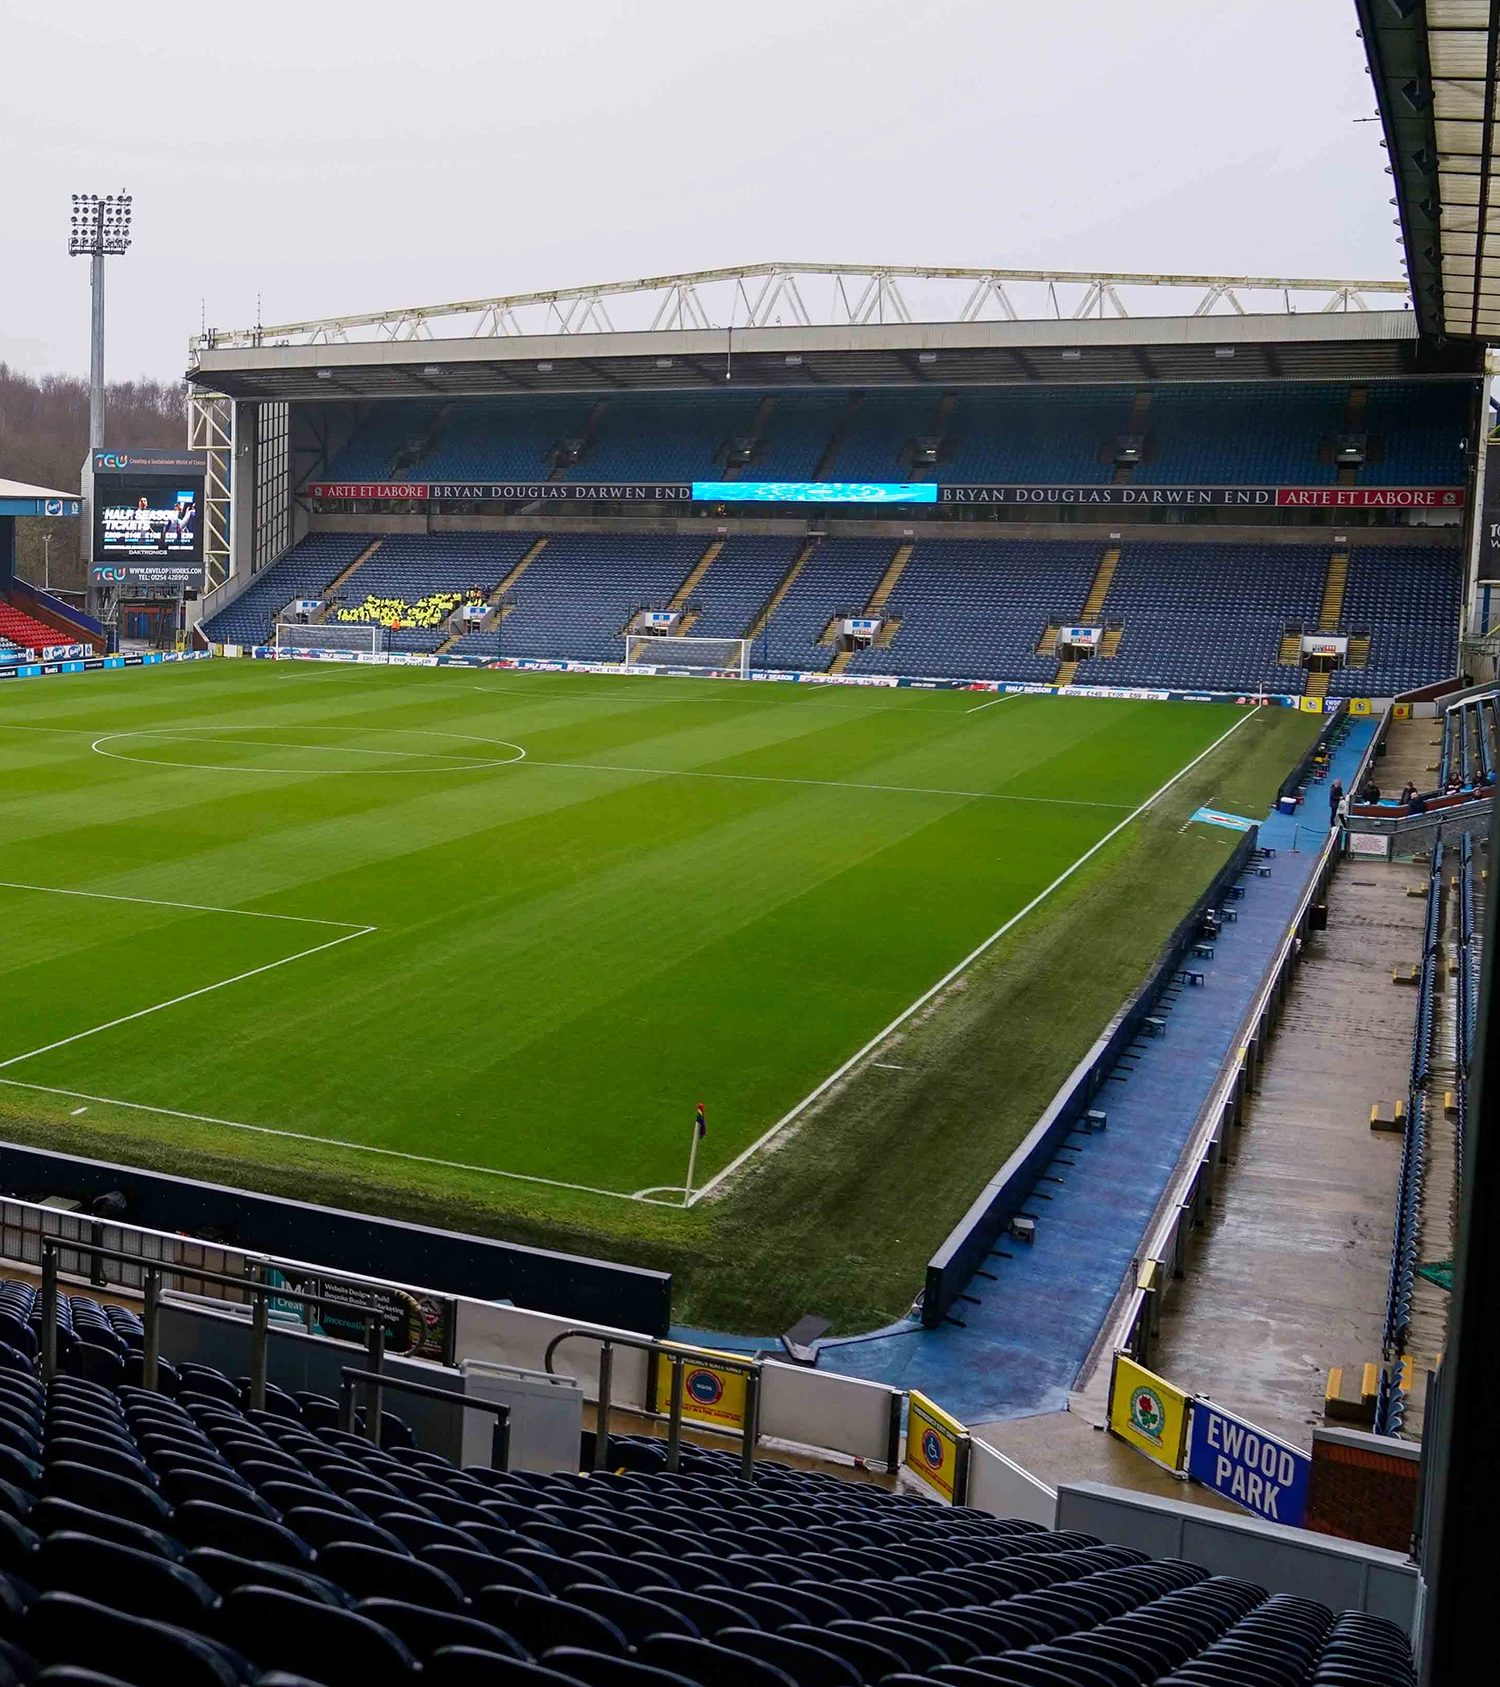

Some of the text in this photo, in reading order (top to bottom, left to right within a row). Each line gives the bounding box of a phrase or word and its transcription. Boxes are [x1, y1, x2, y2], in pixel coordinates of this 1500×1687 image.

[327, 486, 424, 498] ARTE ET LABORE
[433, 486, 690, 499] BRYAN DOUGLAS DARWEN END
[943, 489, 1269, 504] BRYAN DOUGLAS DARWEN END
[1286, 492, 1436, 504] ARTE ET LABORE
[104, 510, 134, 520] HALF
[105, 521, 150, 530] TICKETS
[325, 1283, 348, 1295] Website
[325, 1291, 348, 1302] Bespoke
[1206, 1412, 1295, 1488] EWOOD
[1215, 1454, 1280, 1521] PARK
